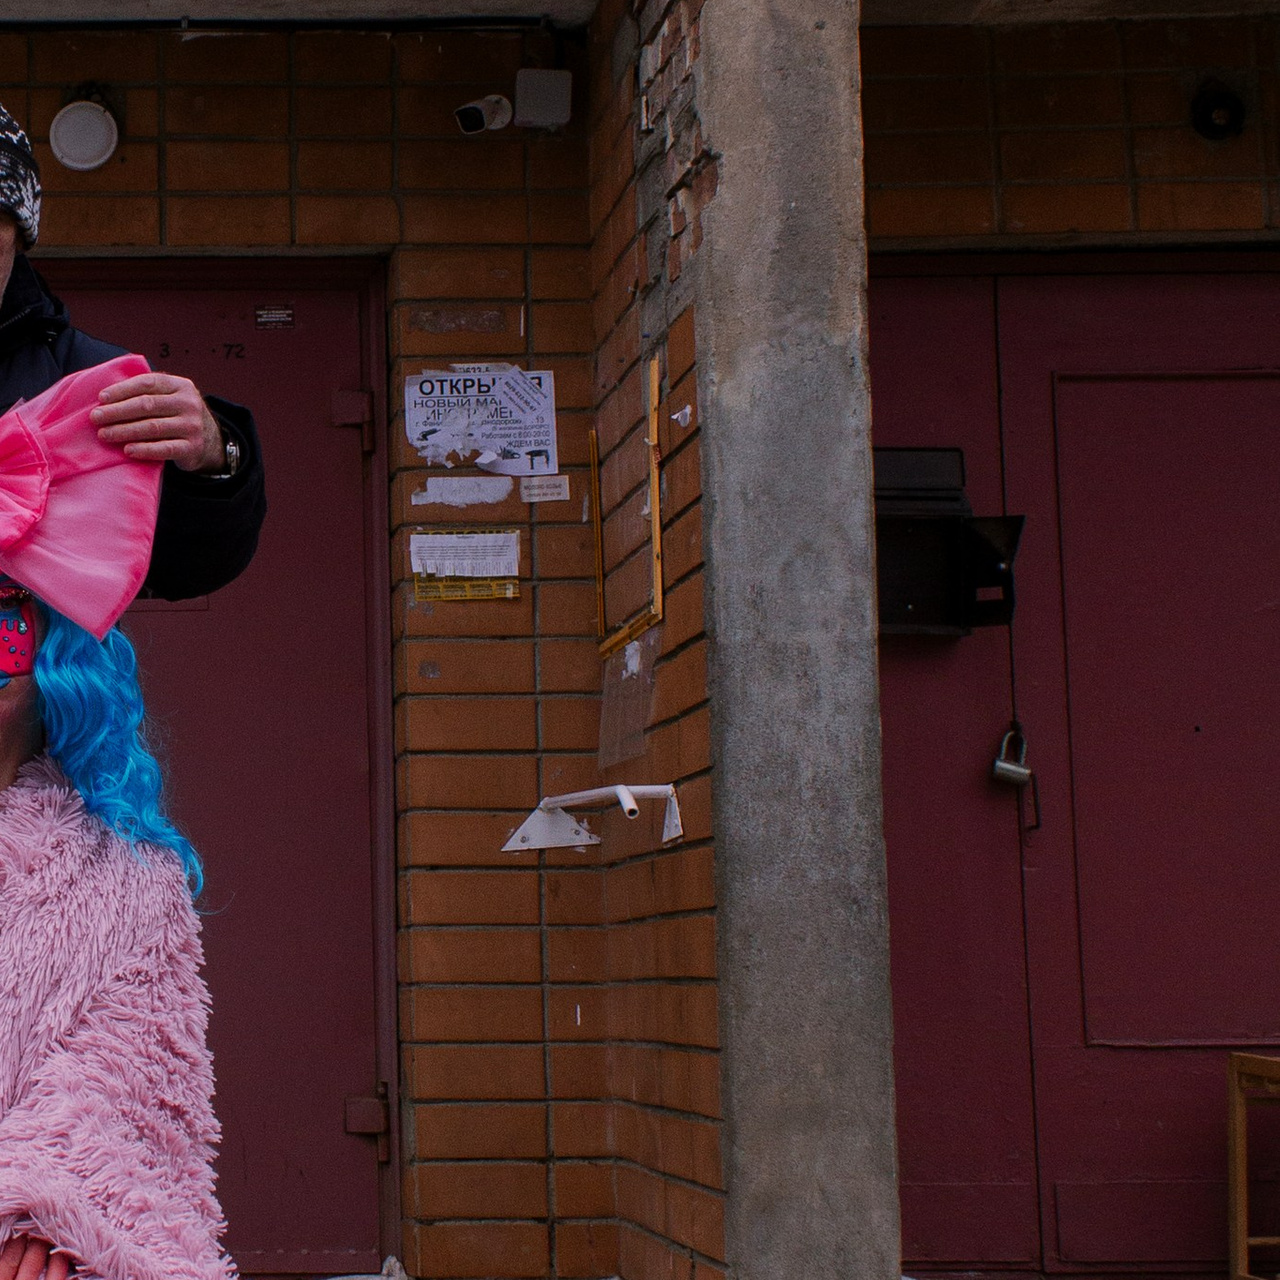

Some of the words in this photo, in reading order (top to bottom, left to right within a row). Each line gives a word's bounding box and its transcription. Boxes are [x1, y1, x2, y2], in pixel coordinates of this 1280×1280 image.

[413, 398, 471, 408] НОВЫЙ
[506, 439, 532, 448] ЖДЕМ
[533, 438, 551, 447] ВАС
